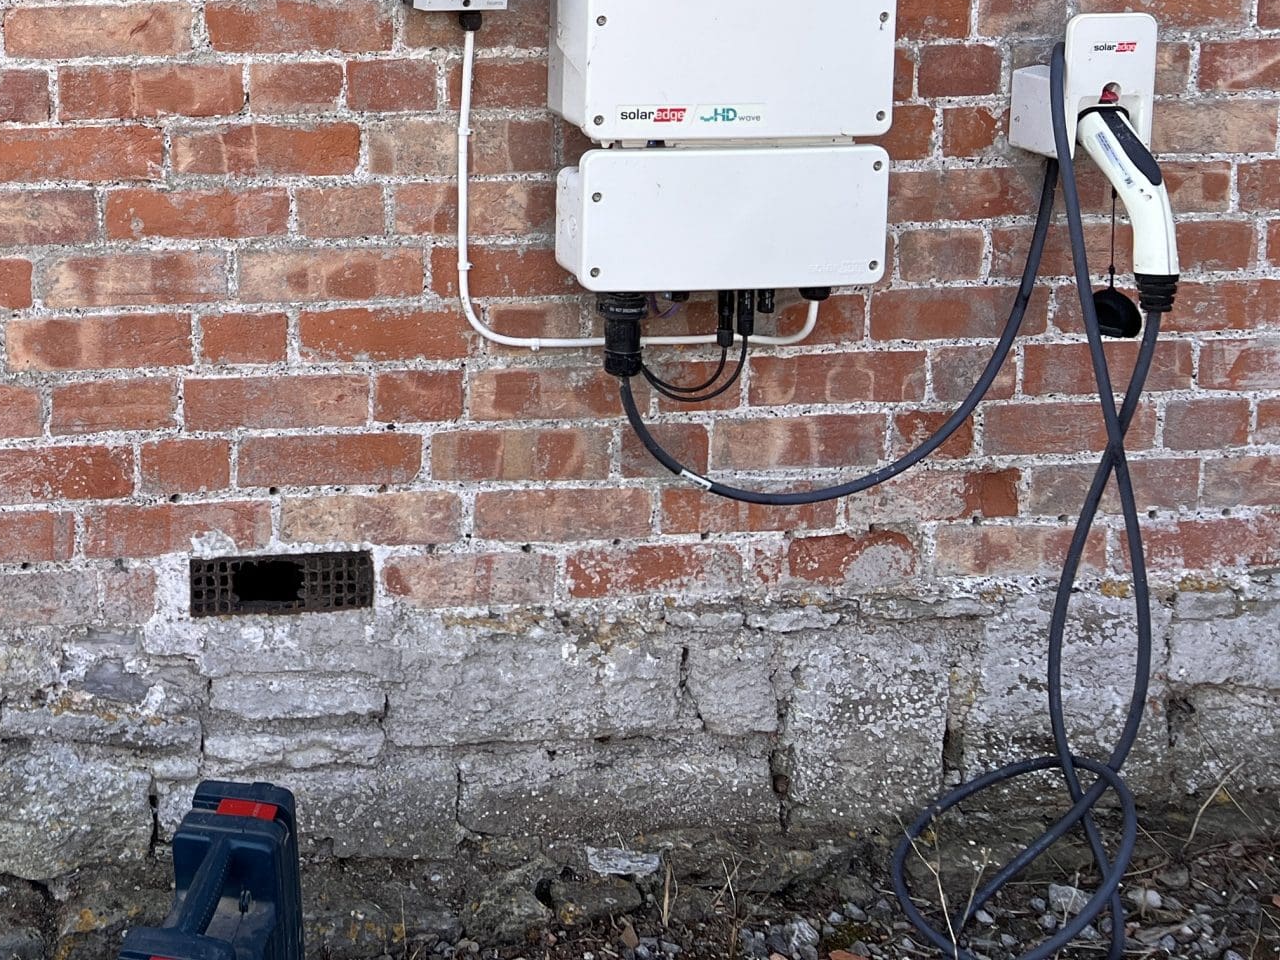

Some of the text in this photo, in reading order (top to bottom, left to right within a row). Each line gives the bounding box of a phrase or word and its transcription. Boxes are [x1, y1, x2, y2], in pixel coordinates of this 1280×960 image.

[620, 108, 761, 122] solaredge HD wave
